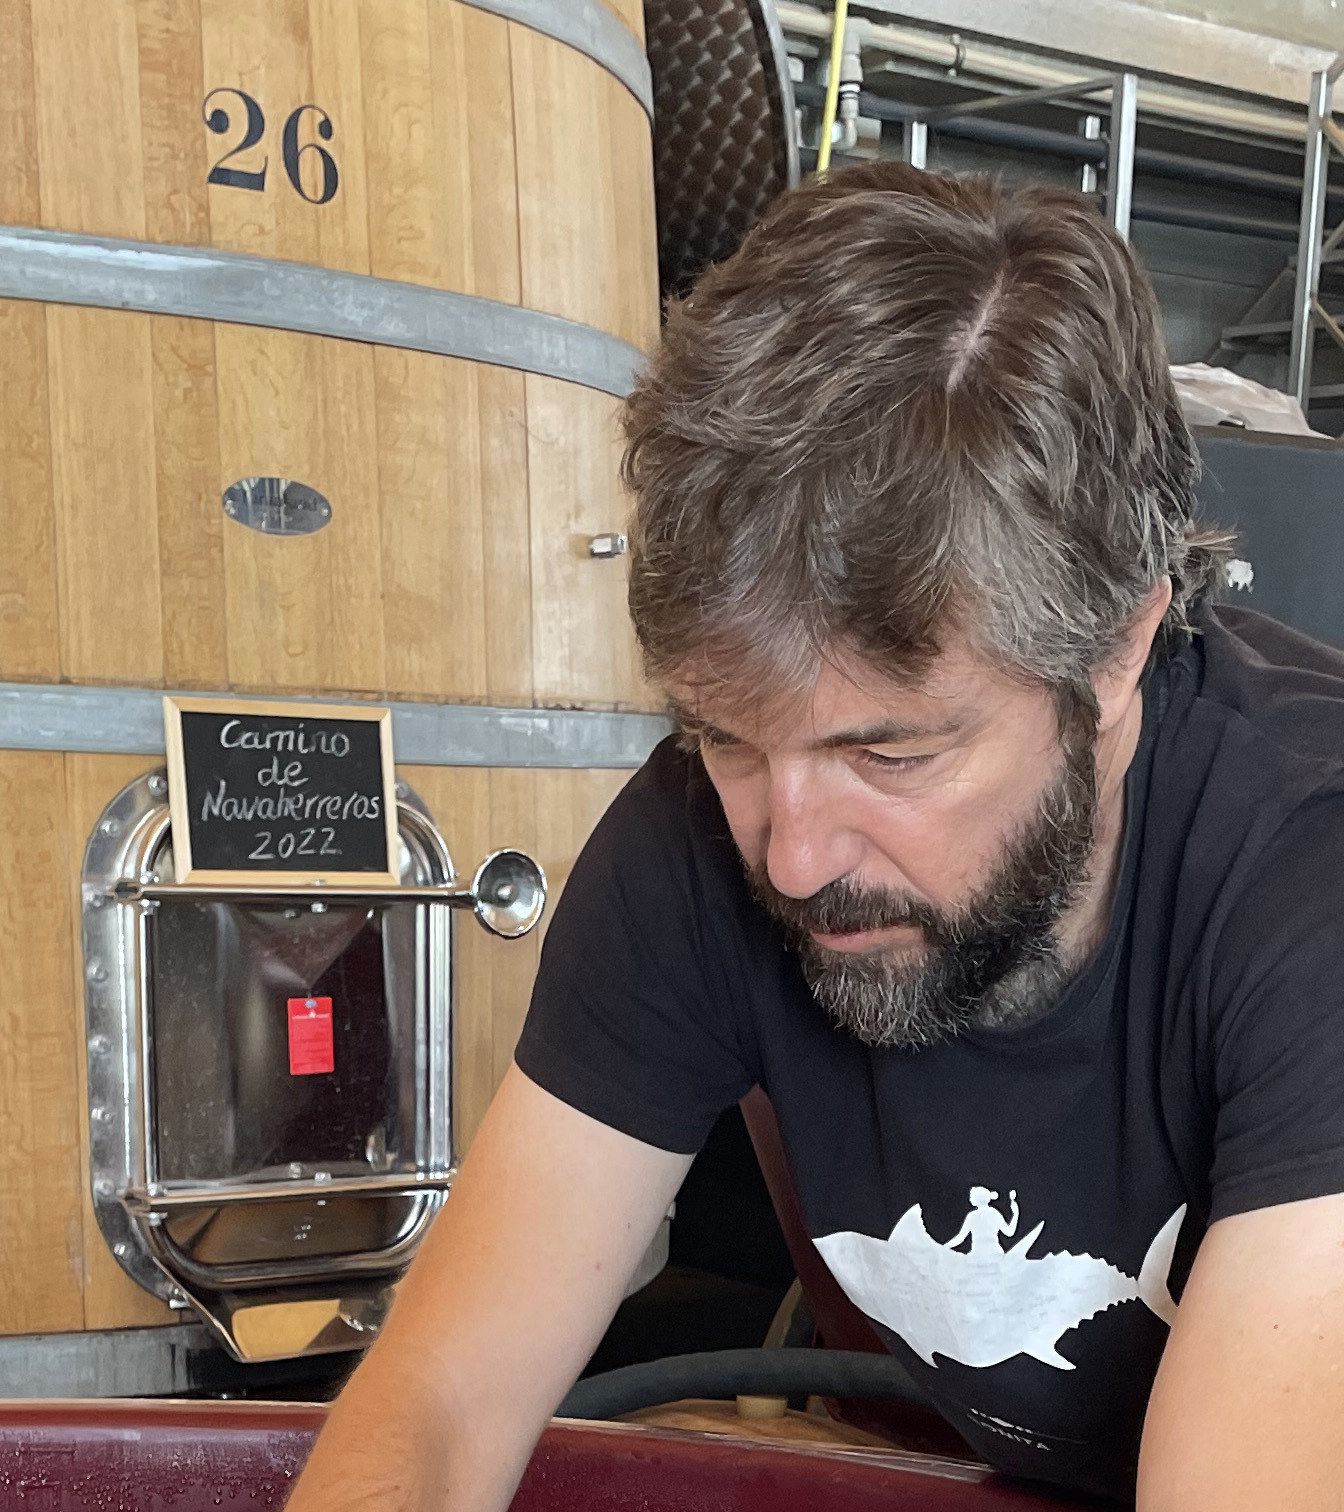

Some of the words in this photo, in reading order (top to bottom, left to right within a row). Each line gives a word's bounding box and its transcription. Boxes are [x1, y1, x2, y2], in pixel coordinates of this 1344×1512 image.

[202, 88, 339, 205] 26
[220, 719, 350, 757] Camino
[257, 755, 309, 787] de
[201, 779, 380, 821] Navaherreros
[248, 827, 344, 860] 2022
